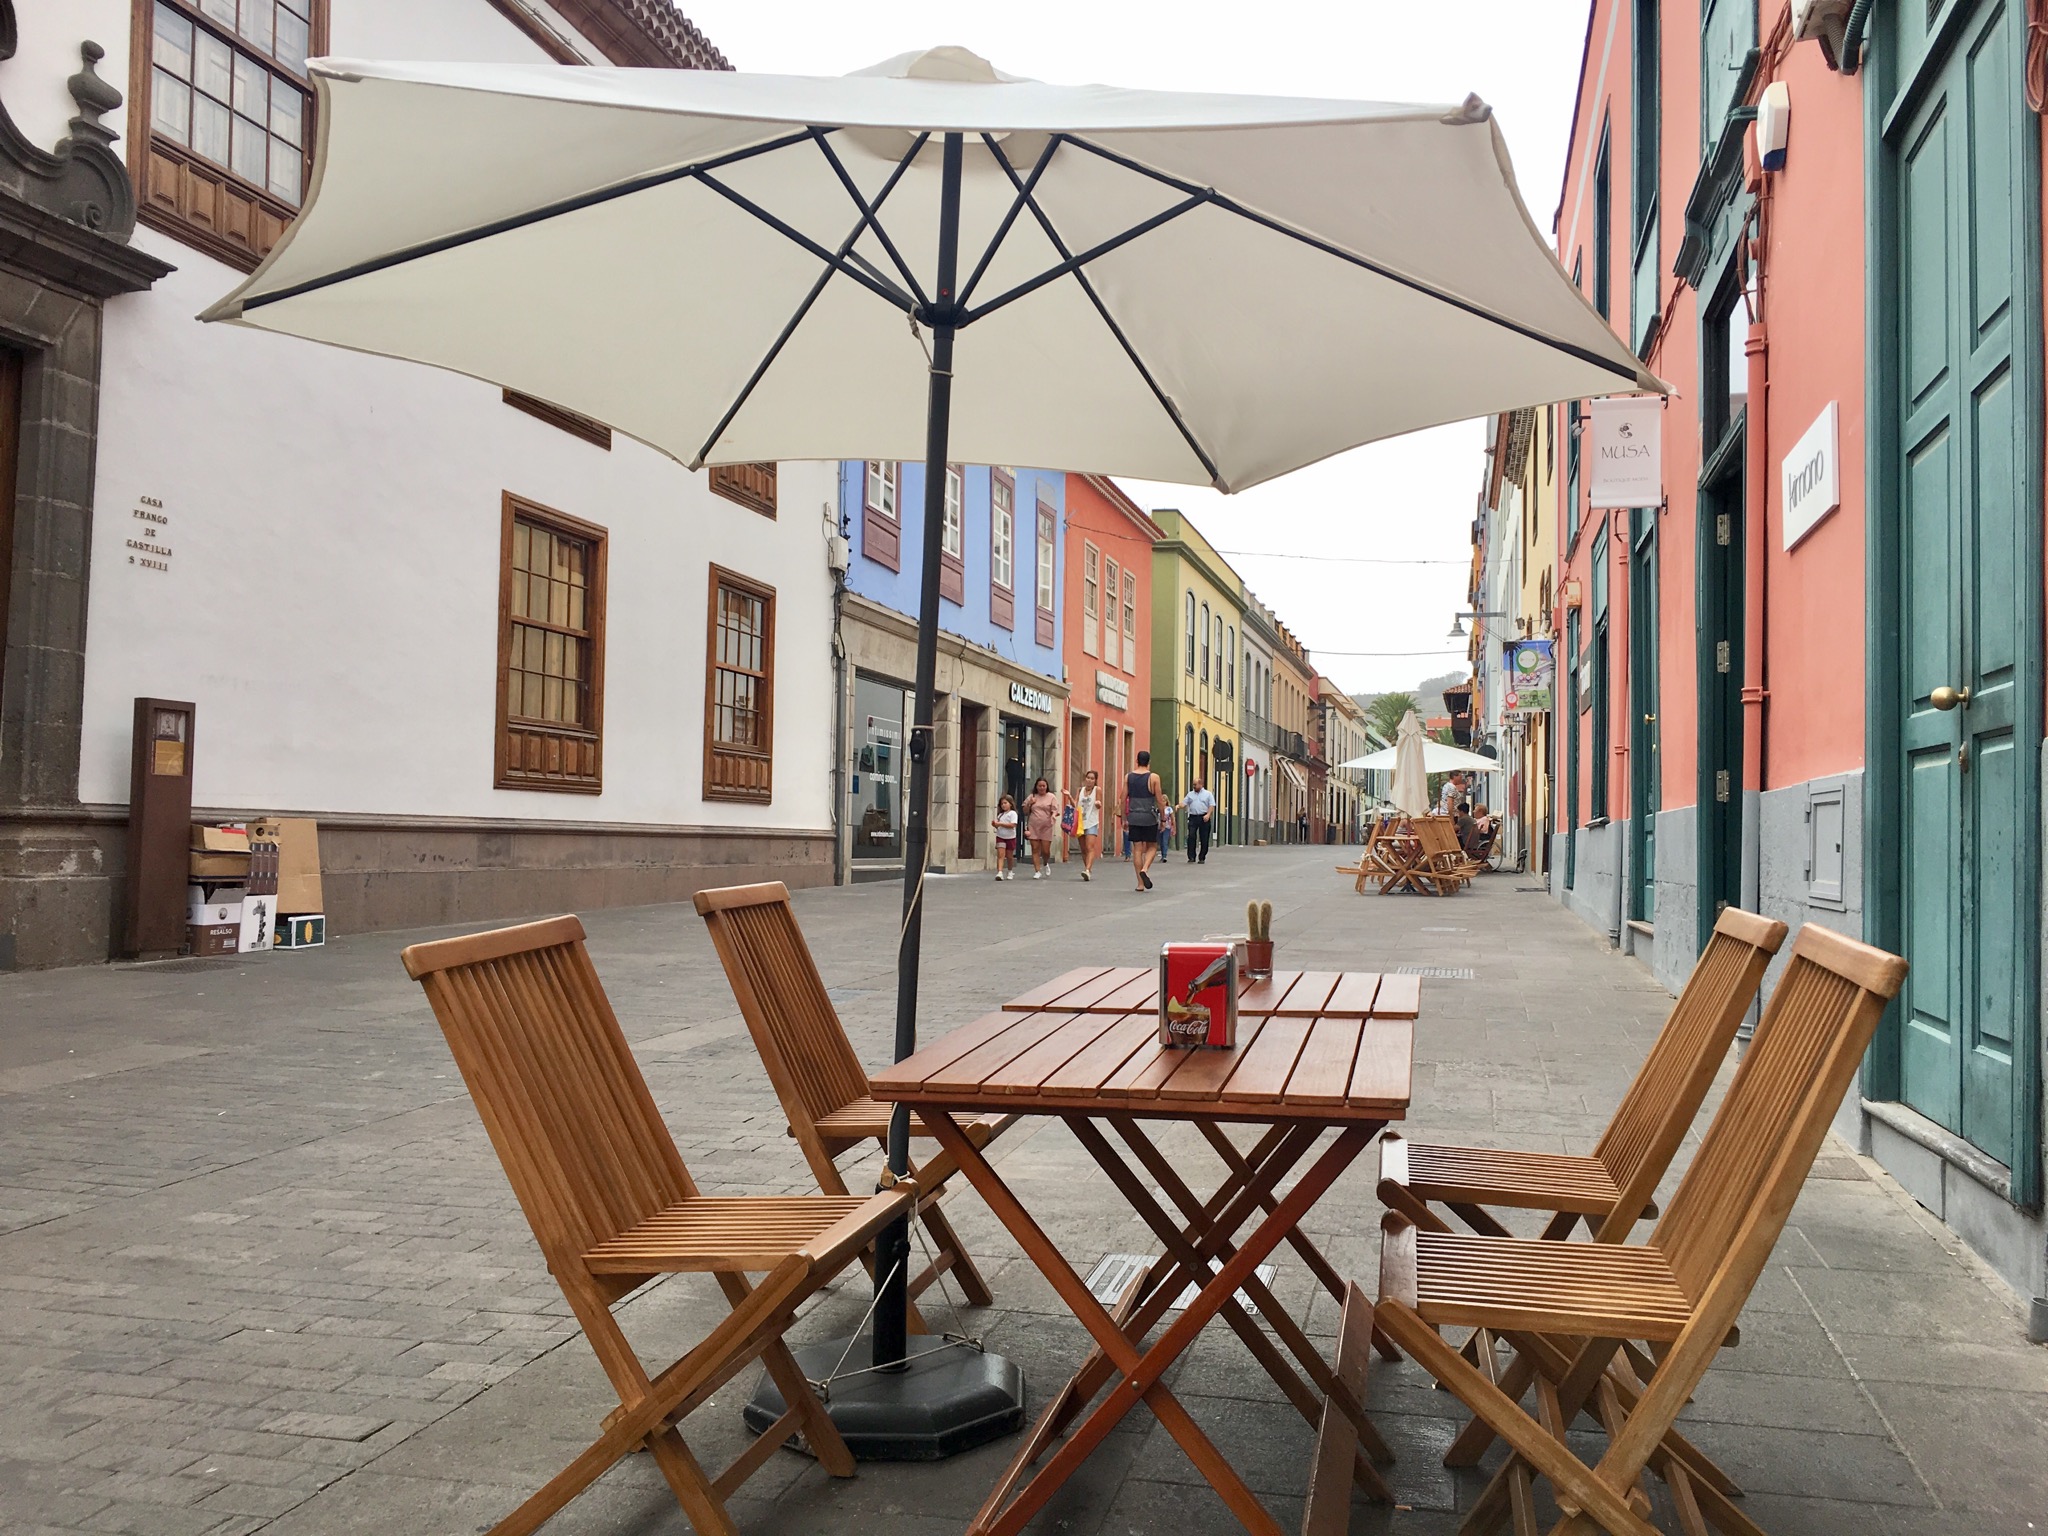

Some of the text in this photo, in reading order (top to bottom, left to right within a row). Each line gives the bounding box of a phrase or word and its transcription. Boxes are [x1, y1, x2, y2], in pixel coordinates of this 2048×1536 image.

[1601, 445, 1651, 459] MUSA
[1788, 449, 1824, 512] kimono
[140, 495, 163, 508] CASA
[132, 509, 168, 525] FRANCO
[144, 527, 156, 537] DE
[126, 539, 172, 556] CASTILLA
[128, 555, 168, 571] S XVIII
[1010, 682, 1052, 714] CALZEDONIA
